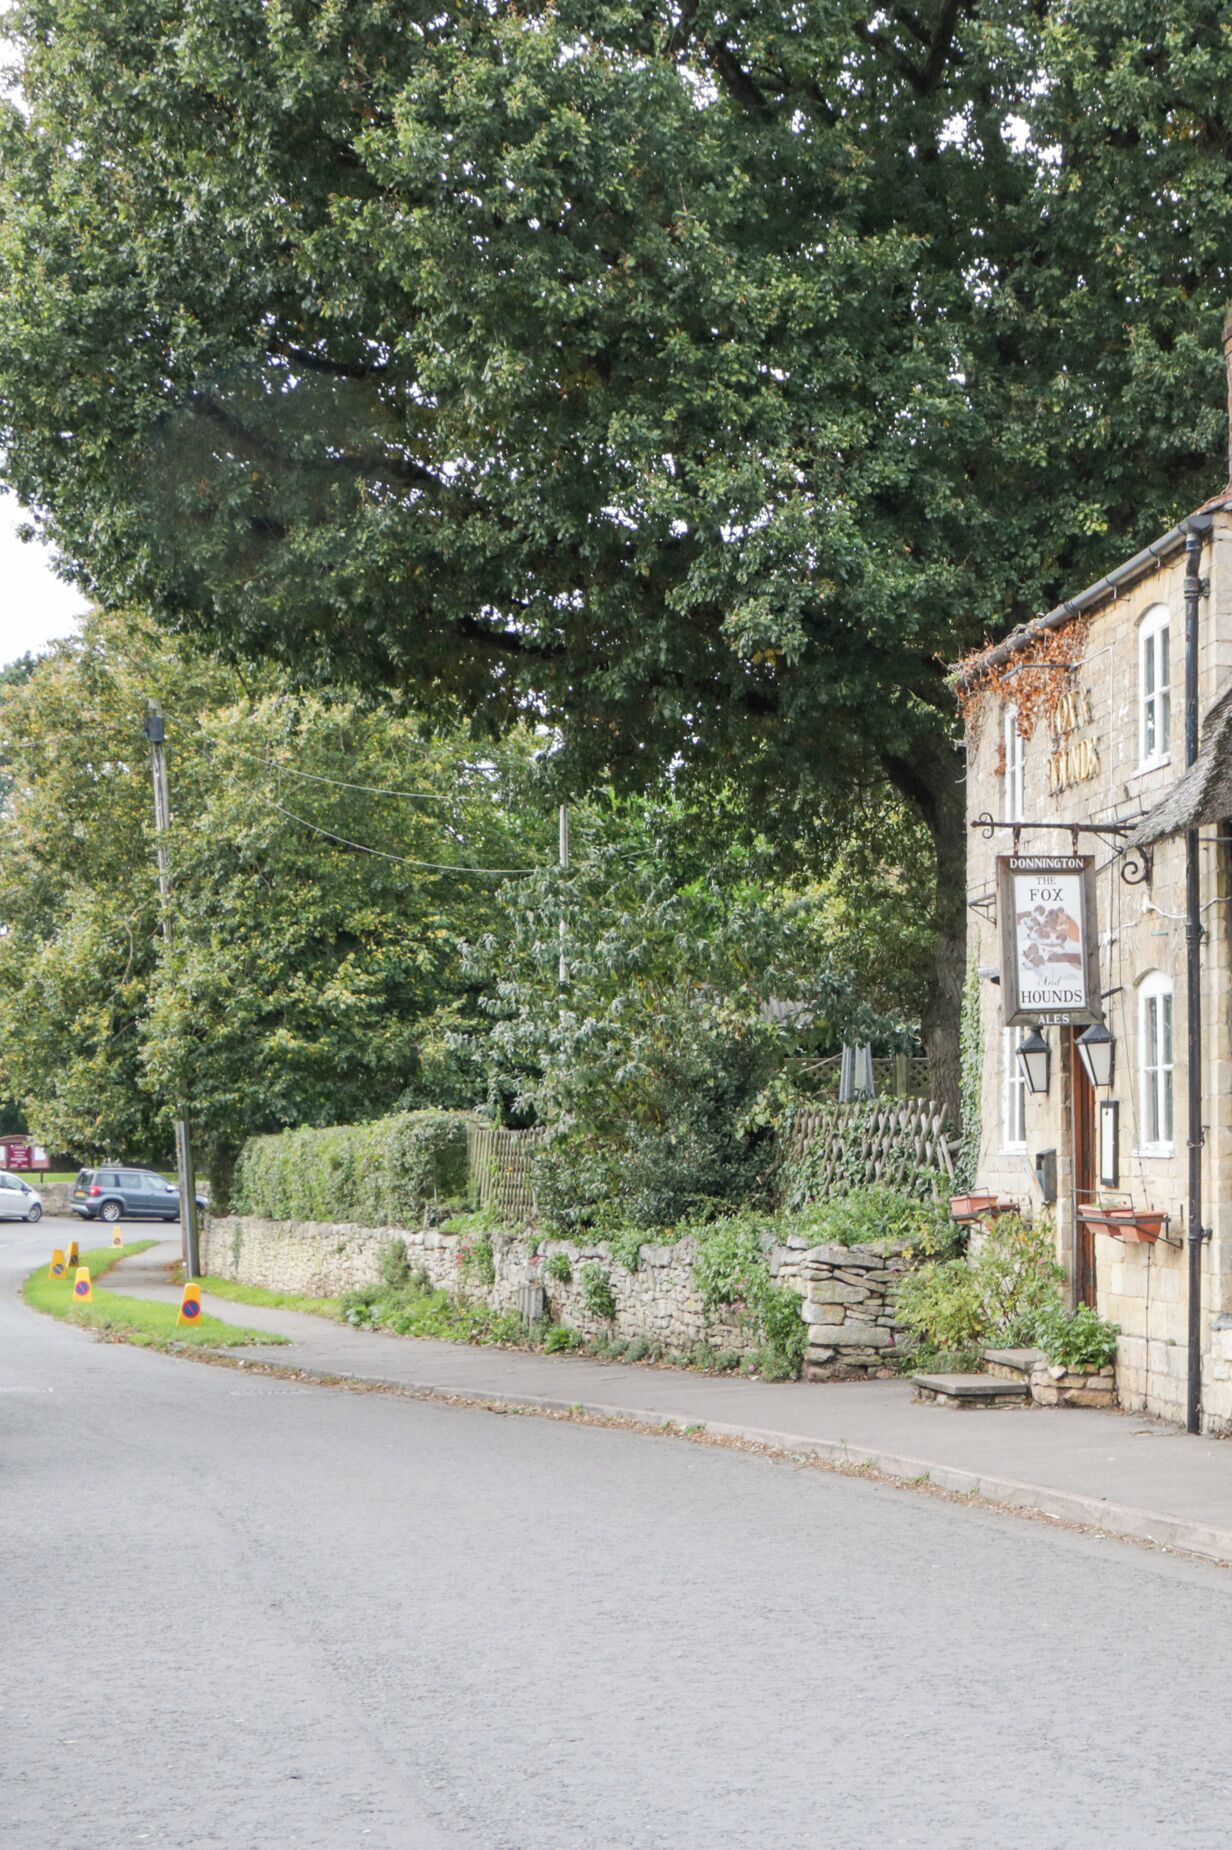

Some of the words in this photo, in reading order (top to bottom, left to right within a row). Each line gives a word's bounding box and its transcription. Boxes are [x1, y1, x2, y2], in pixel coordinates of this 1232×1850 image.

[1009, 857, 1084, 869] DONNINGTON
[1035, 876, 1056, 885] THE
[1029, 888, 1064, 901] FOX
[1038, 975, 1062, 987] And
[1021, 989, 1083, 1003] HOUNDS
[1038, 1013, 1070, 1024] ALES
